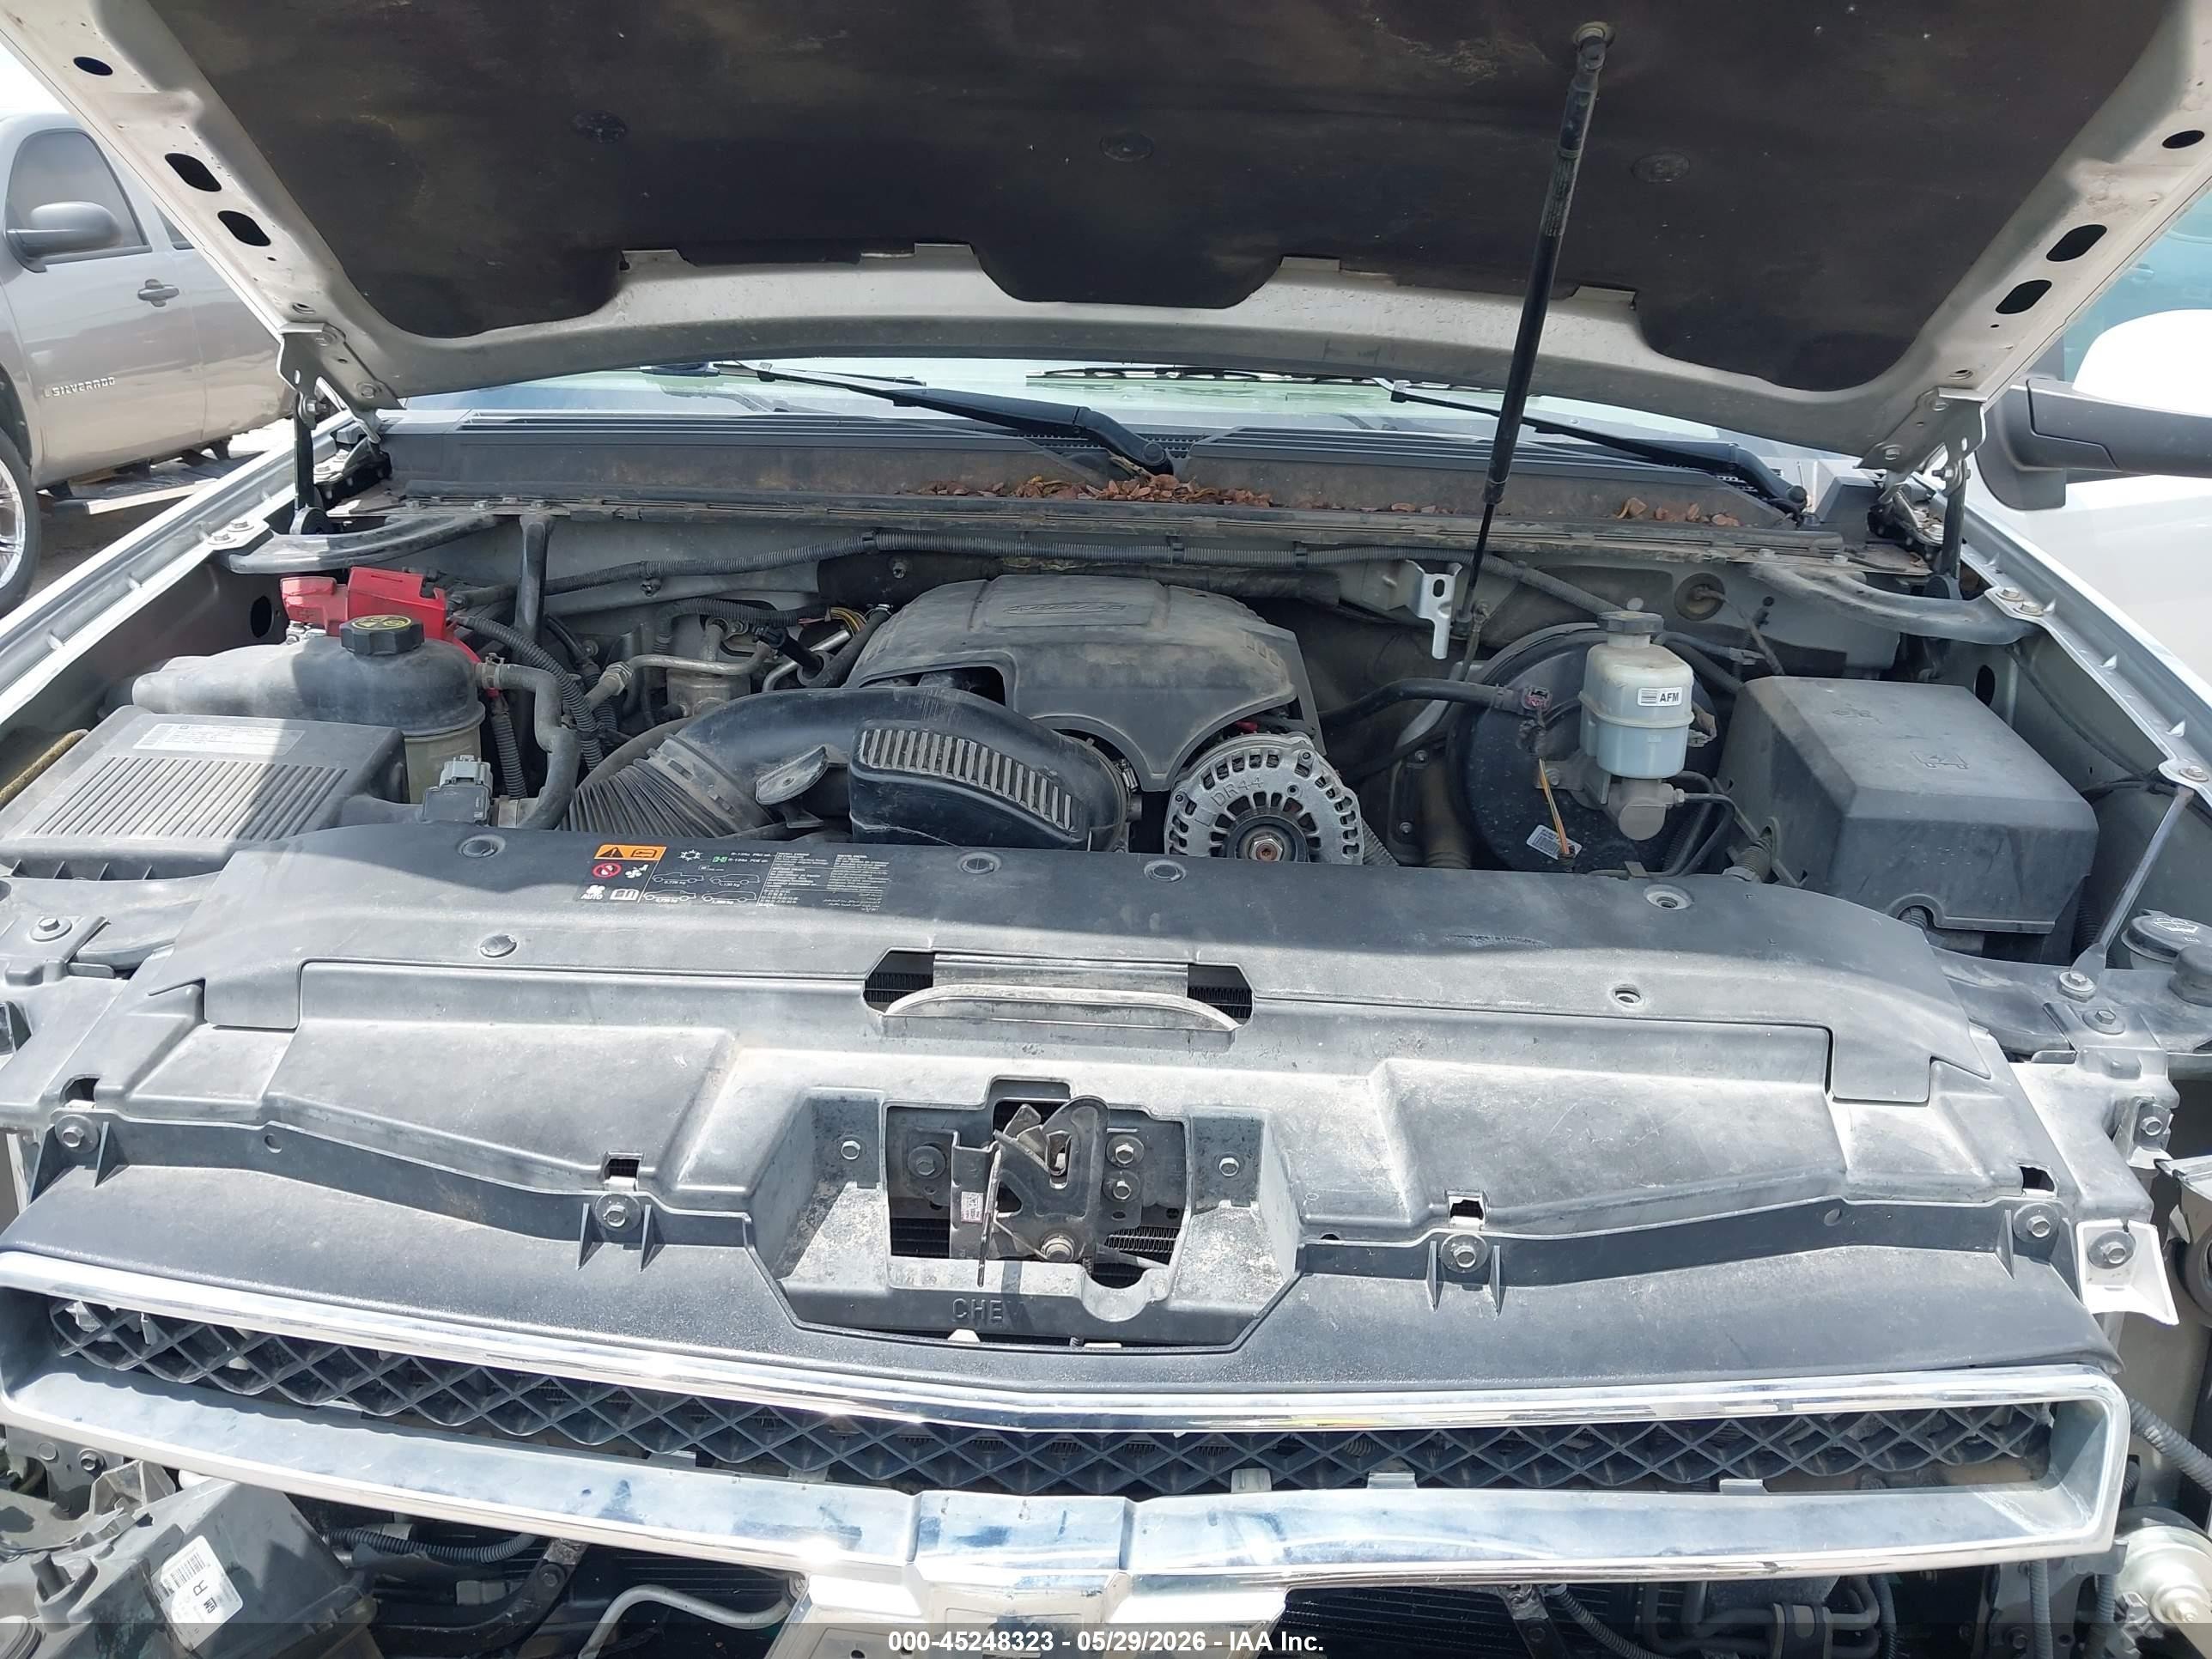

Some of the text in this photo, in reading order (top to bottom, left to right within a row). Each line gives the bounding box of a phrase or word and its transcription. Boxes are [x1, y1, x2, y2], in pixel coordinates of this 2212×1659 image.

[52, 376, 116, 397] SILVERADO
[1659, 692, 1680, 702] AFM
[1210, 776, 1265, 807] DR44
[203, 1596, 218, 1614] GM
